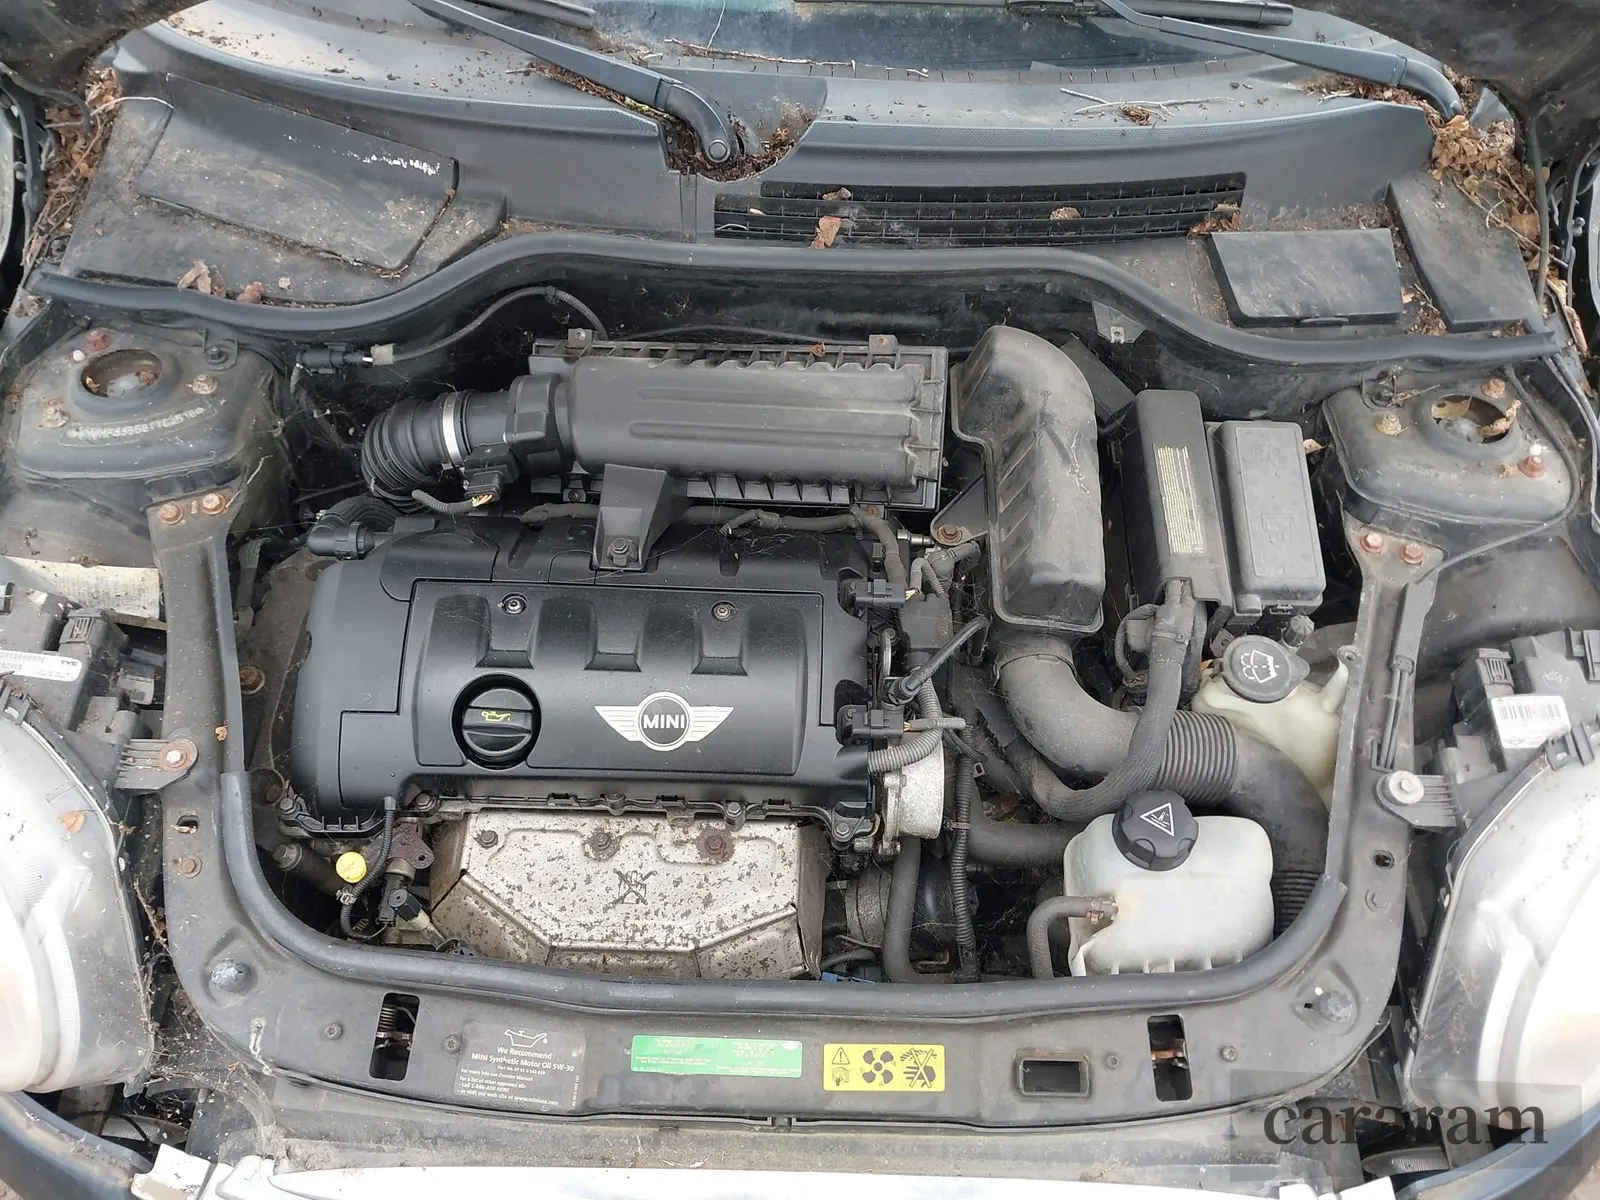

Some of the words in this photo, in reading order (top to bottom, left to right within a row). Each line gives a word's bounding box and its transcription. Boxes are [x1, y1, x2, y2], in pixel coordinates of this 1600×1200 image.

[643, 714, 685, 729] MINI
[497, 1046, 508, 1055] We
[509, 1047, 553, 1060] Recommend
[471, 1053, 488, 1061] MINI
[489, 1055, 519, 1066] Synthetic
[520, 1057, 542, 1068] Motor
[542, 1060, 552, 1069] Oil
[552, 1063, 575, 1072] 5W-30
[497, 1080, 518, 1088] approved
